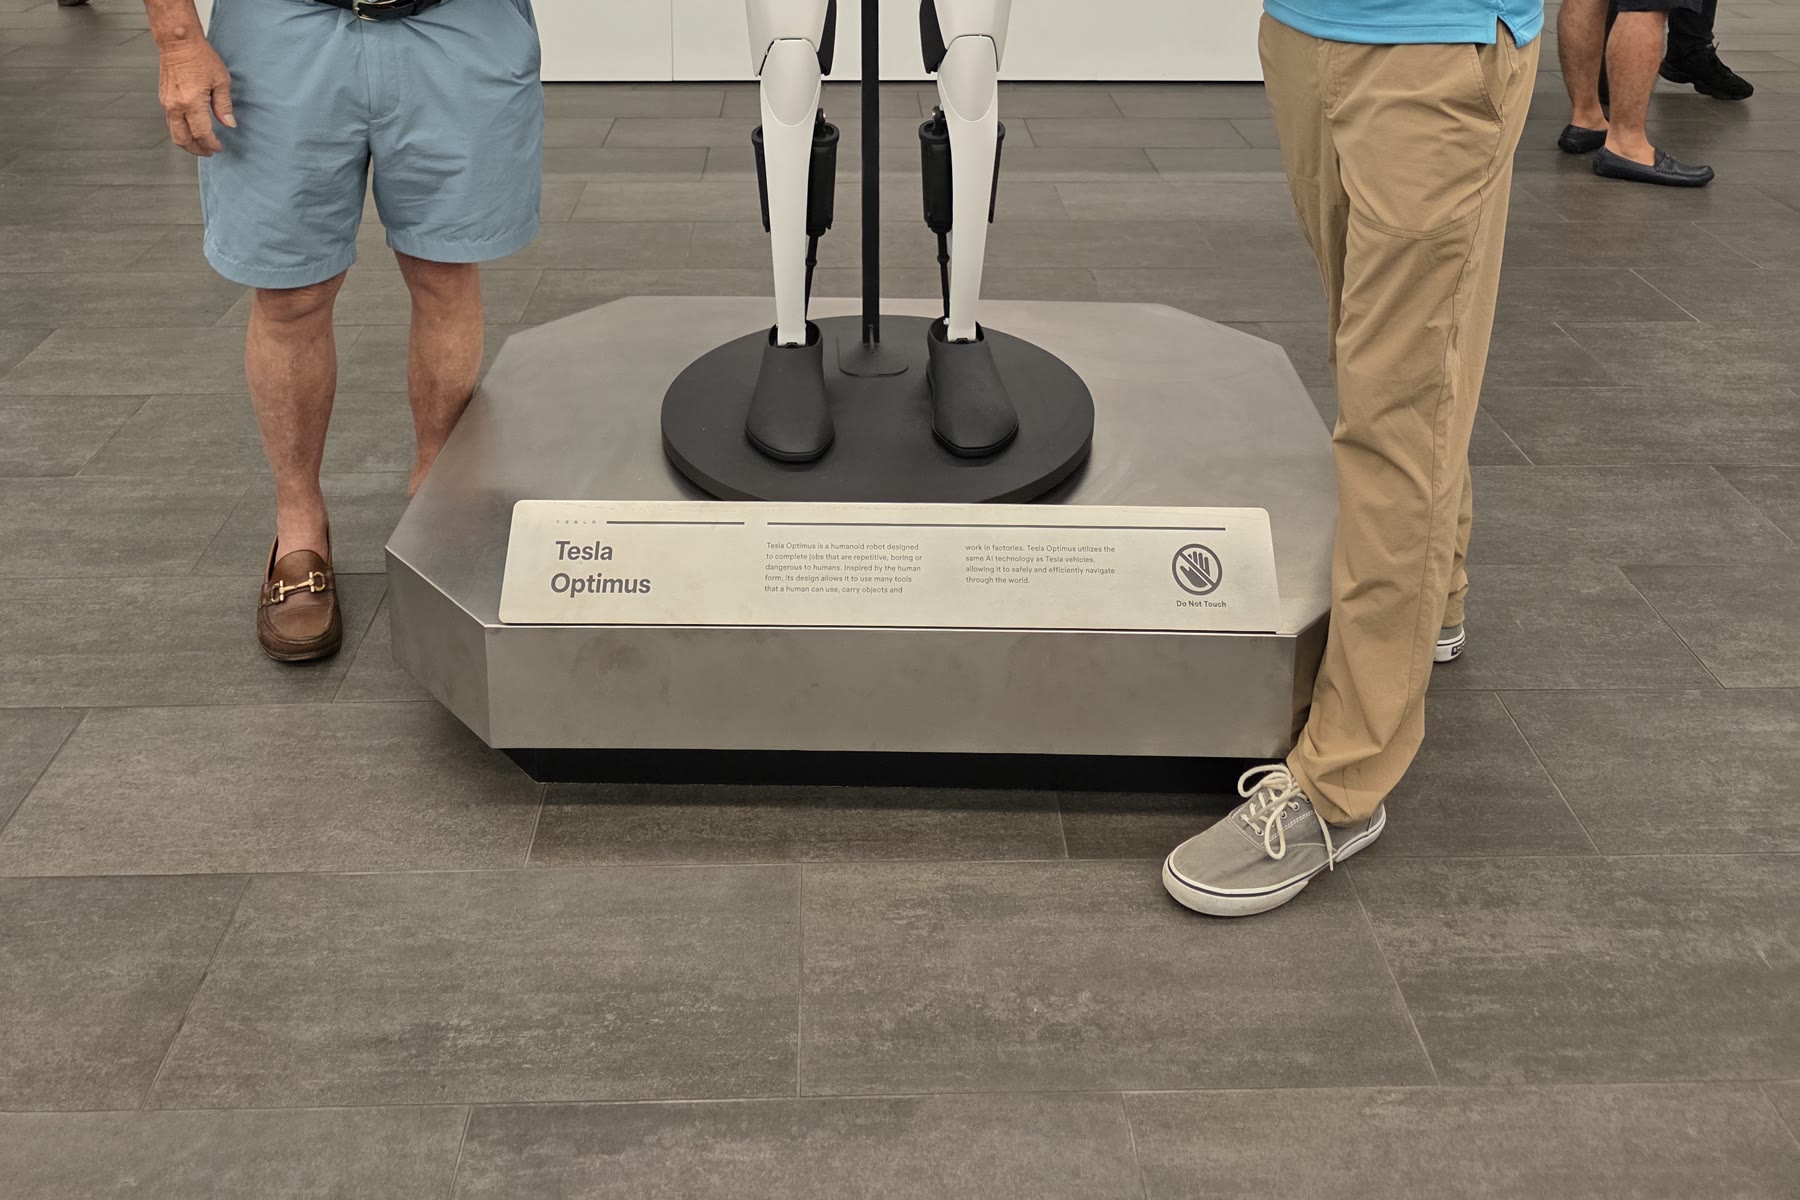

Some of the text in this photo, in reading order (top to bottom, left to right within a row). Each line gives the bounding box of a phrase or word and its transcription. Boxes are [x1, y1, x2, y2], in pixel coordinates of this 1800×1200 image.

[555, 541, 613, 560] Tesla
[786, 542, 816, 550] Optimus
[1046, 545, 1076, 553] Optimus
[774, 553, 808, 561] complete
[809, 553, 824, 561] jobs
[890, 554, 914, 562] boring
[995, 555, 1034, 563] technology
[1065, 556, 1096, 564] vehicles,
[765, 563, 802, 571] dangerous
[844, 564, 873, 572] Inspired
[874, 564, 883, 572] by
[966, 566, 995, 574] allowing
[1011, 566, 1033, 574] safely
[1048, 566, 1084, 575] efficiently
[765, 574, 784, 582] form,
[795, 575, 819, 583] design
[966, 576, 993, 584] through
[551, 572, 651, 598] Optimus
[861, 586, 888, 594] objects
